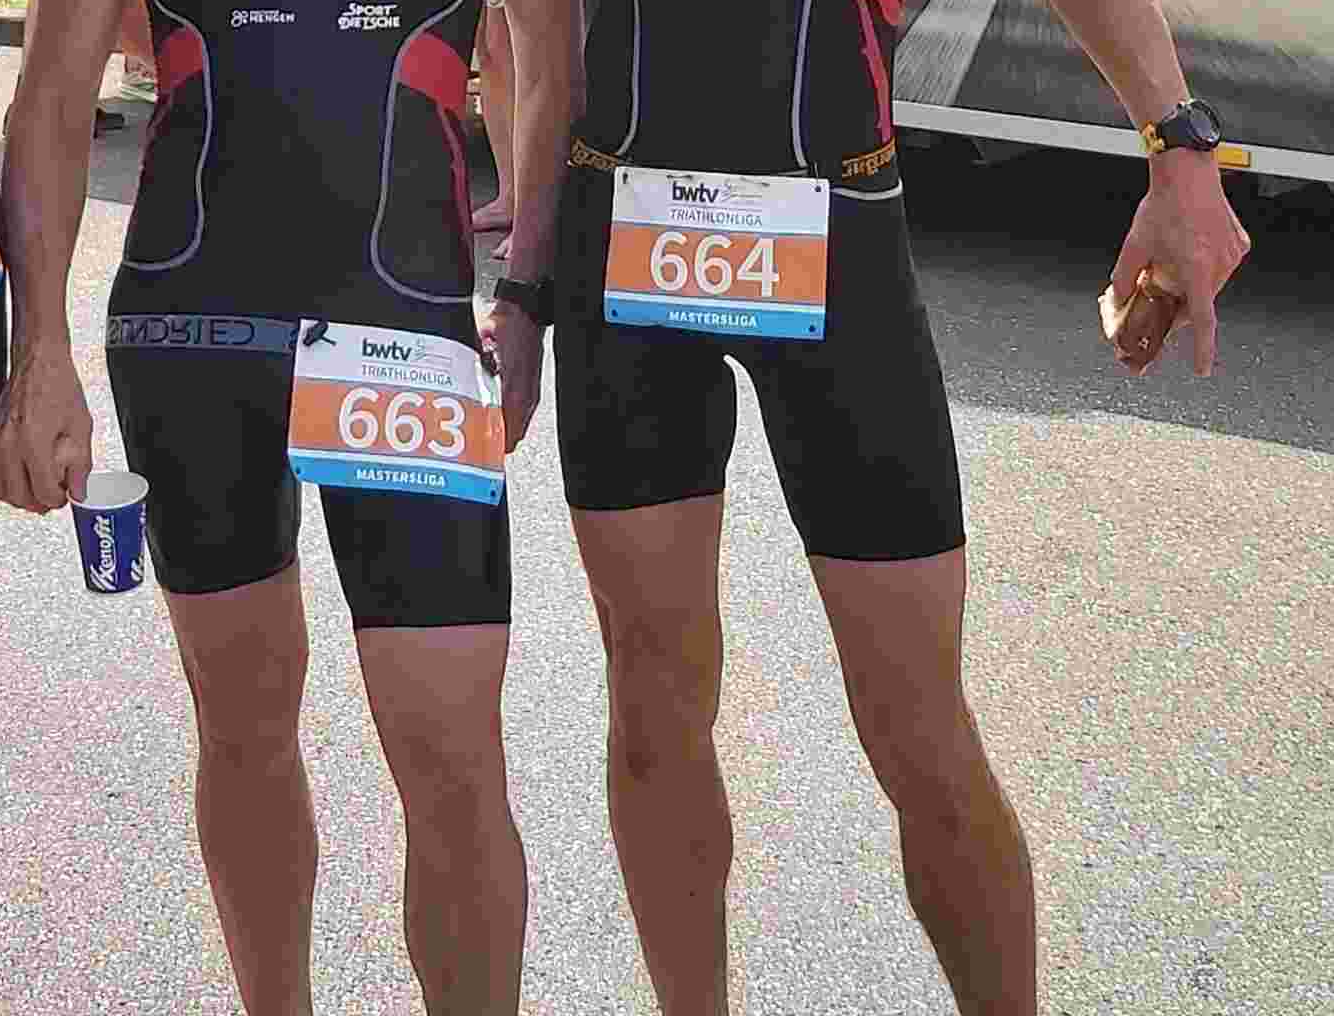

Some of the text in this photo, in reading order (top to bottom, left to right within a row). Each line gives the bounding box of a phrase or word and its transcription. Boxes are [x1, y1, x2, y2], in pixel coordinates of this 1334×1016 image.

[342, 3, 398, 16] SPORT
[672, 182, 719, 203] bwtv
[669, 208, 763, 226] TRIATHLONLIGA
[650, 231, 780, 298] 664
[669, 310, 758, 328] MASTERSLIGA
[361, 338, 412, 361] bwtv
[361, 364, 454, 387] TRIATHLONLIGA
[338, 387, 466, 458] 663
[355, 468, 446, 487] MASTERSLIGA
